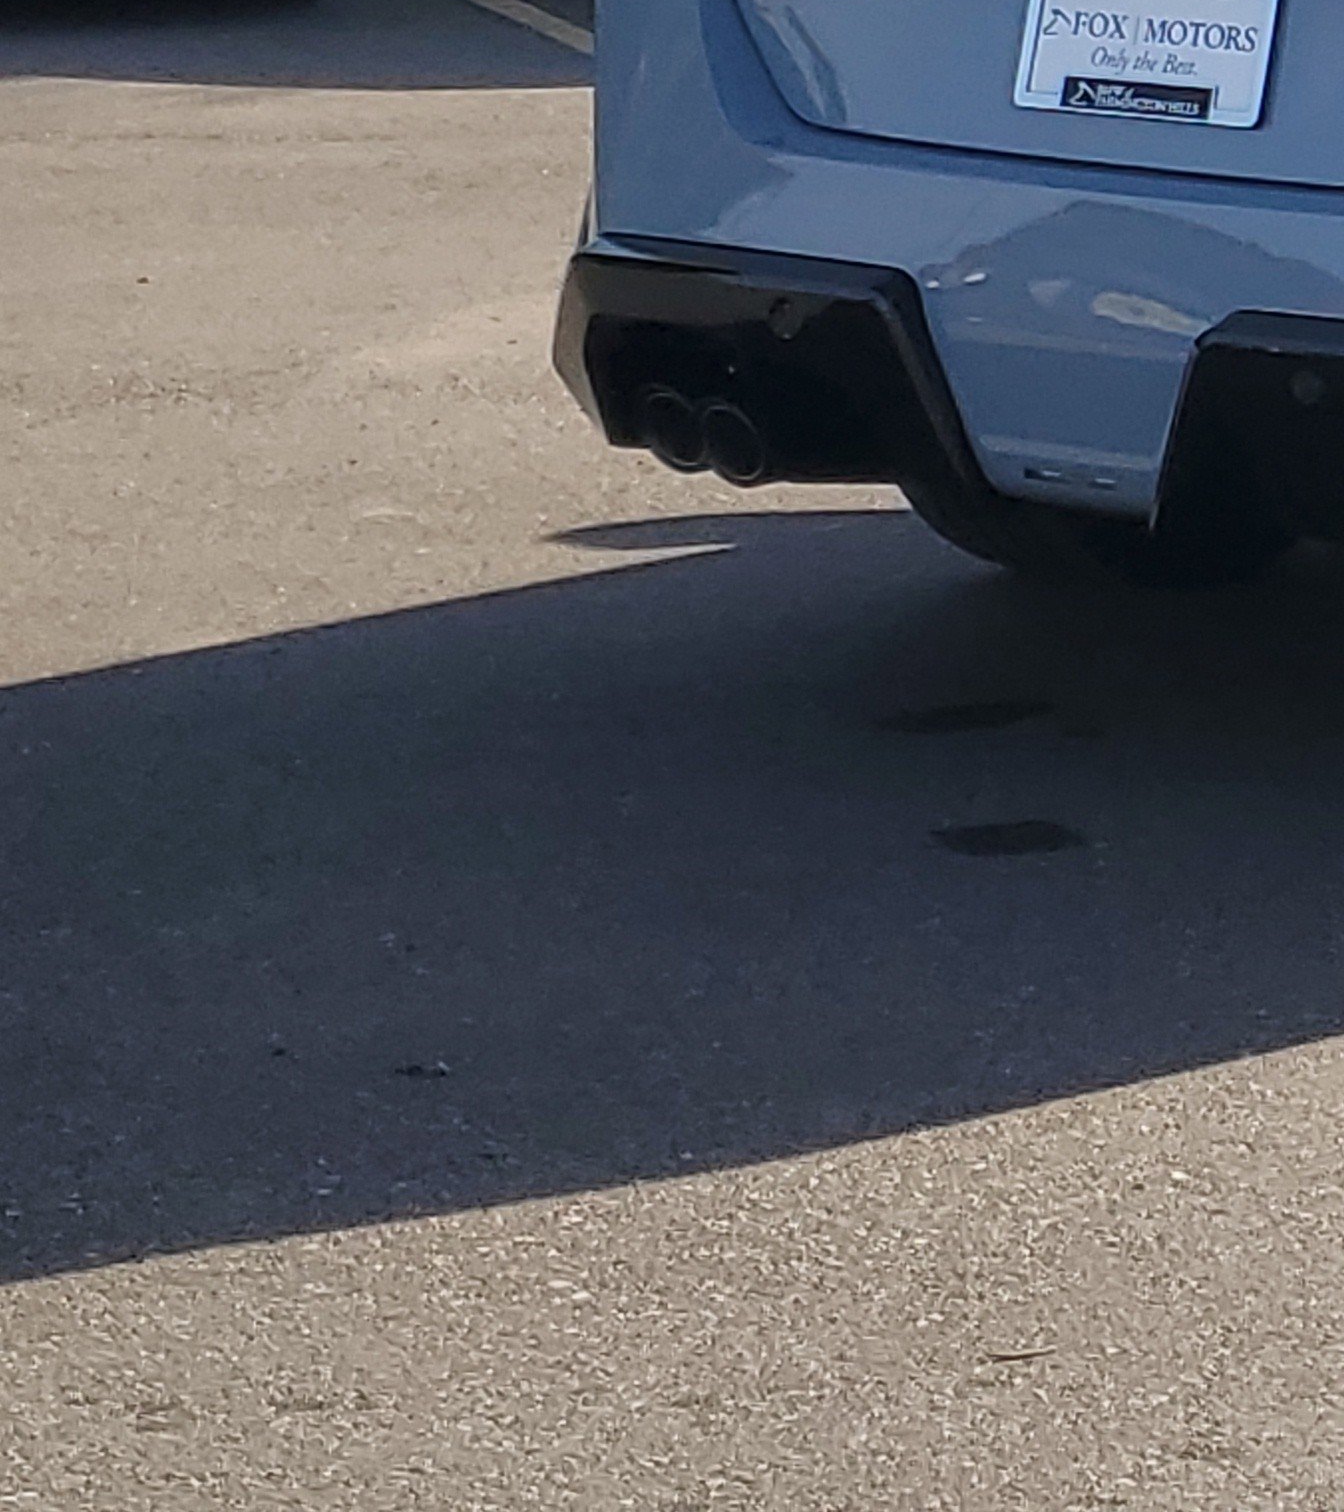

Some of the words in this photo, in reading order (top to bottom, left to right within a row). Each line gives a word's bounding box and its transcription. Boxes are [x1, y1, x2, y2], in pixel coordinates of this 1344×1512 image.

[1072, 10, 1129, 39] FOX
[1144, 17, 1258, 53] MOTORS
[1090, 45, 1129, 76] Only
[1132, 49, 1158, 72] the
